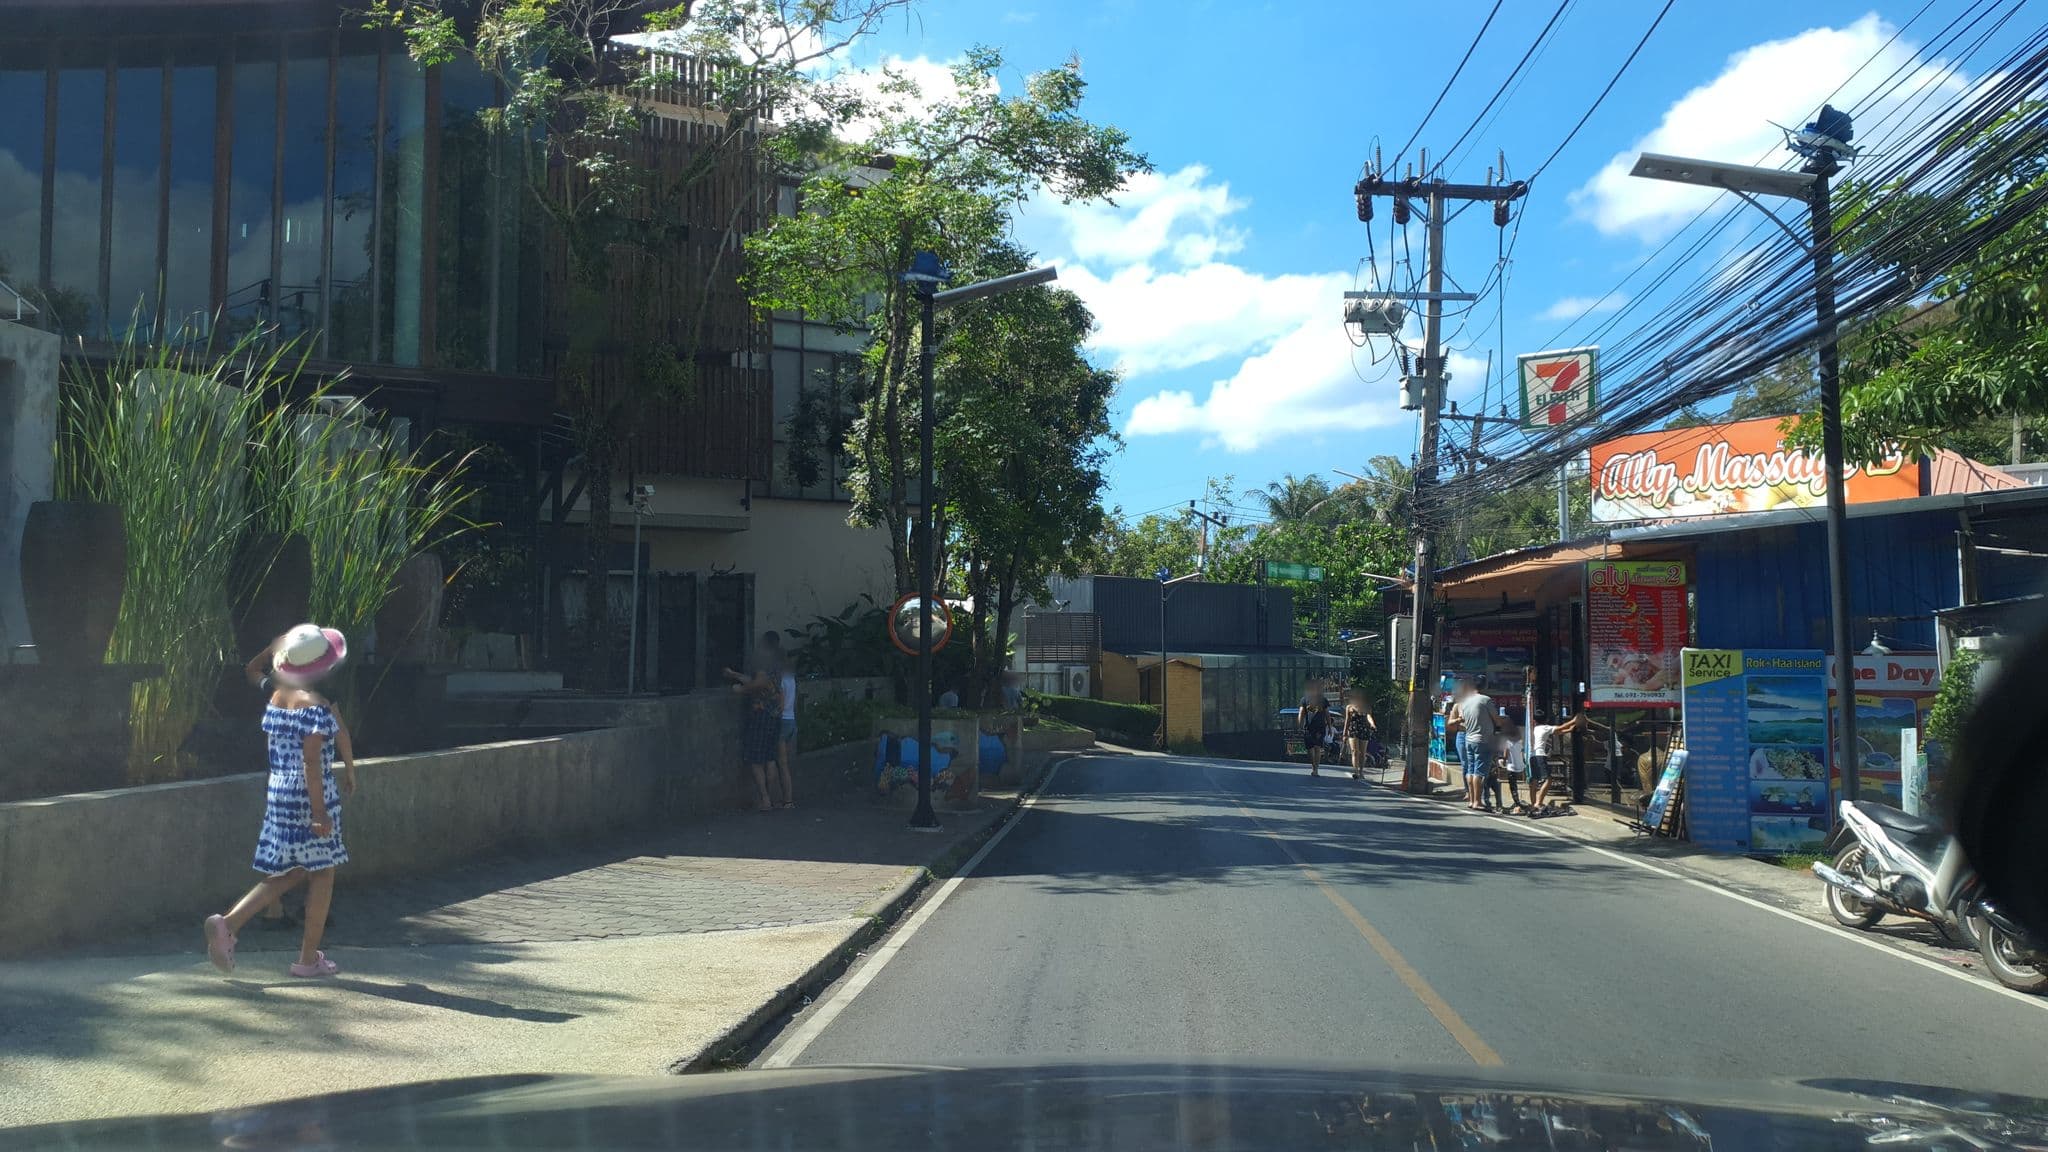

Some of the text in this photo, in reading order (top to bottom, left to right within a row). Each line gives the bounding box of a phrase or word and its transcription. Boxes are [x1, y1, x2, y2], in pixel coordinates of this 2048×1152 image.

[1536, 360, 1580, 425] 7
[1689, 654, 1732, 668] TAXI
[1794, 657, 1821, 668] Island
[1688, 668, 1731, 678] Service
[1887, 662, 1936, 686] Day
